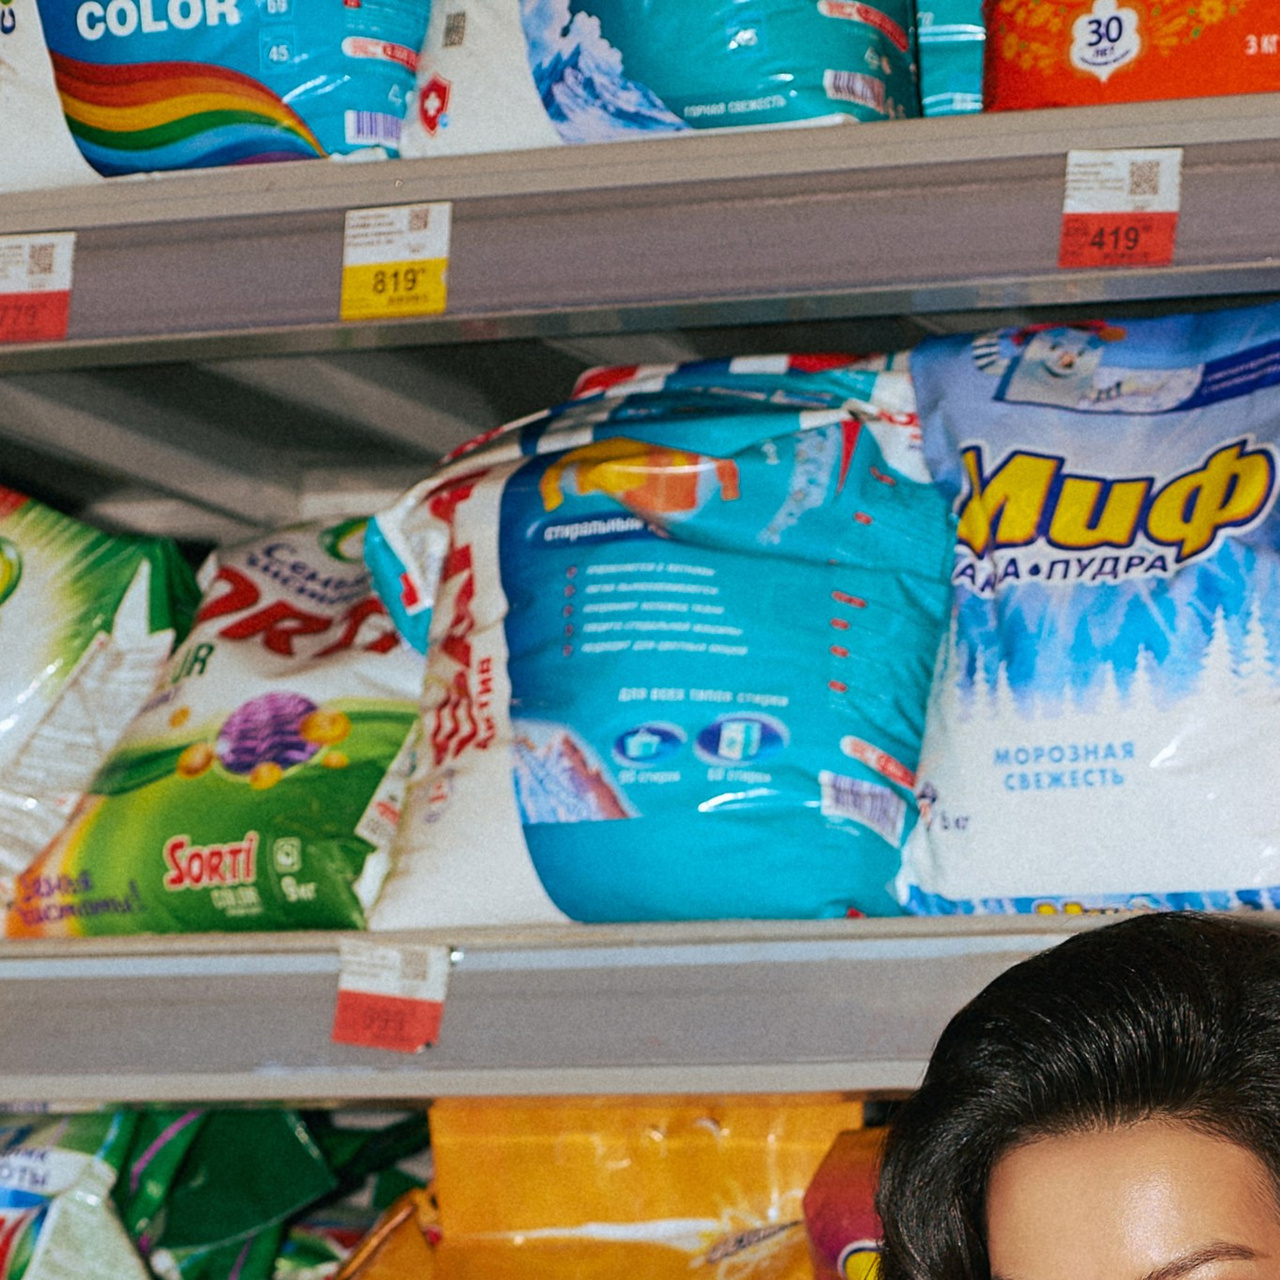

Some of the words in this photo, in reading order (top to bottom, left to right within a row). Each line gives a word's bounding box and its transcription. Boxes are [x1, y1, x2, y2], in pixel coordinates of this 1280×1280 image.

[77, 0, 240, 41] COLOR
[1087, 16, 1123, 47] 30
[1090, 226, 1140, 252] 419
[373, 268, 417, 294] 819
[959, 441, 1277, 558] Миф
[995, 741, 1135, 765] МОРОЗНАЯ
[1004, 768, 1125, 791] СВЕЖЕСТЬ
